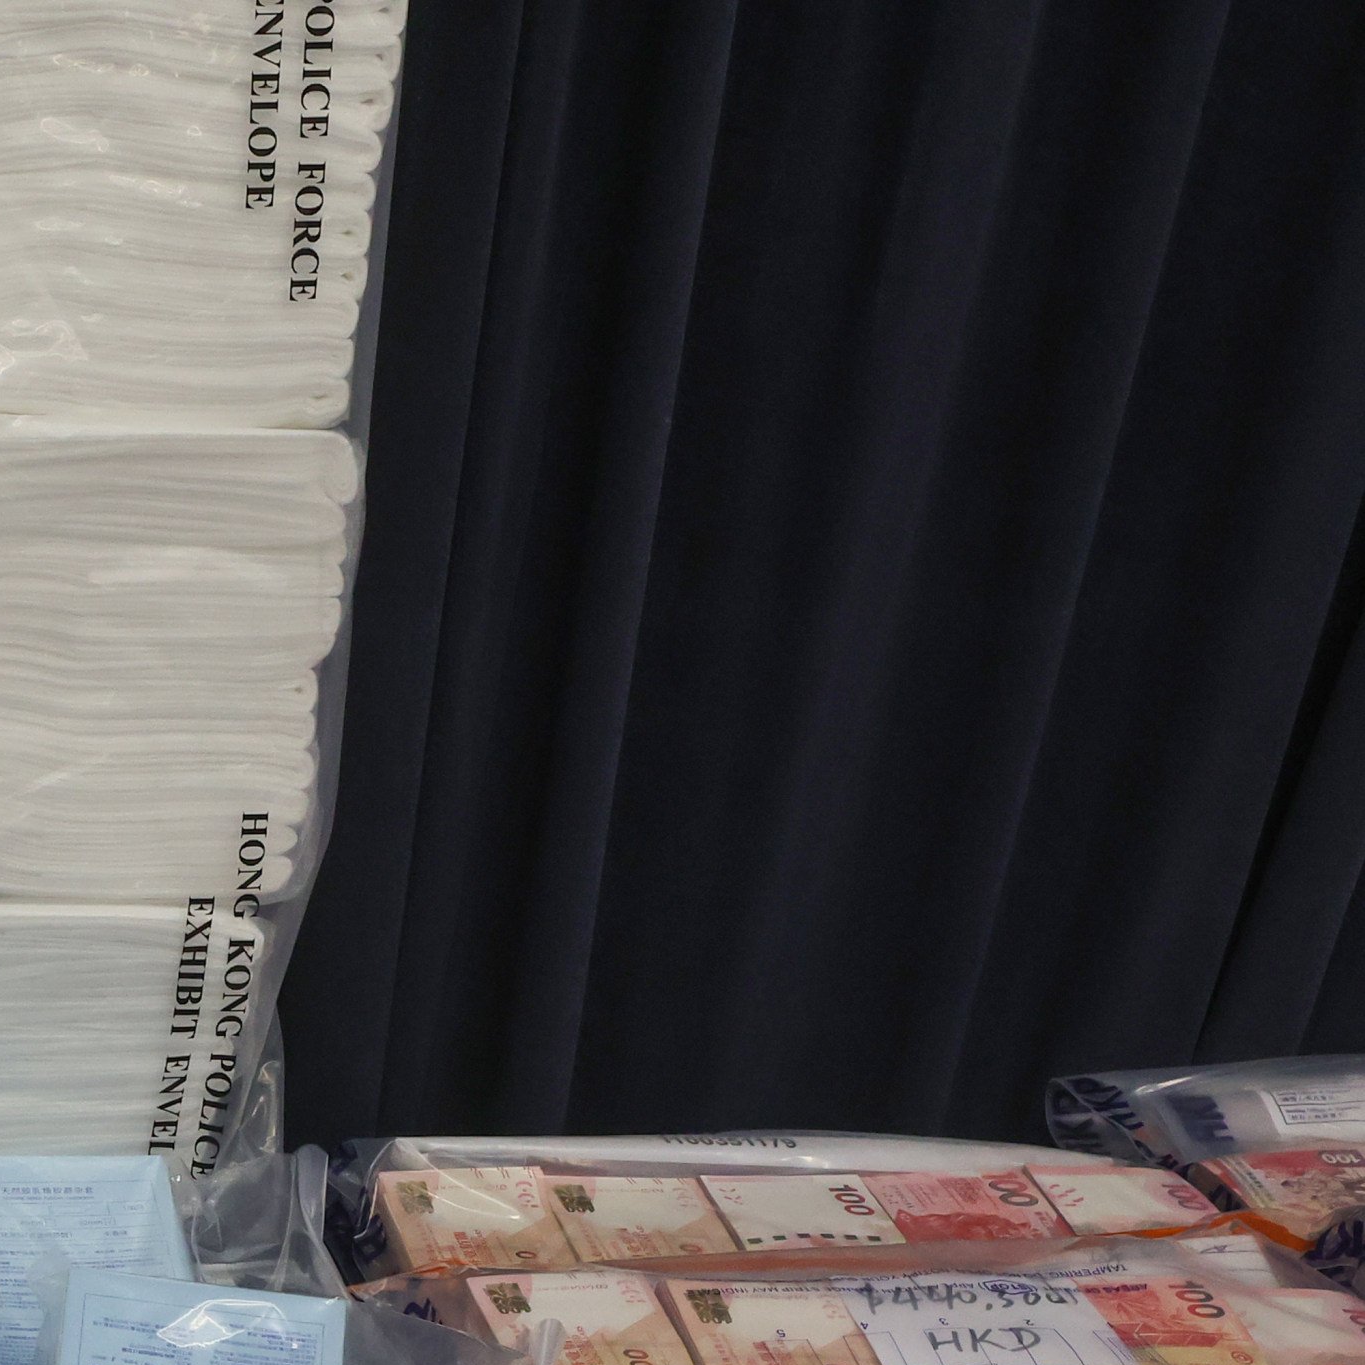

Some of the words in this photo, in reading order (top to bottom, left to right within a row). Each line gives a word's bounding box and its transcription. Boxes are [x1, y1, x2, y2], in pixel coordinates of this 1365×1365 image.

[245, 0, 284, 209] NVELOPE
[300, 0, 335, 138] OLICE
[289, 162, 326, 301] FORCE
[232, 813, 269, 920] HONG
[170, 896, 215, 1039] EXHIBIT
[215, 939, 255, 1038] KONG
[190, 1053, 237, 1180] POLICE
[828, 1184, 876, 1216] 100
[927, 1327, 1042, 1353] HKD
